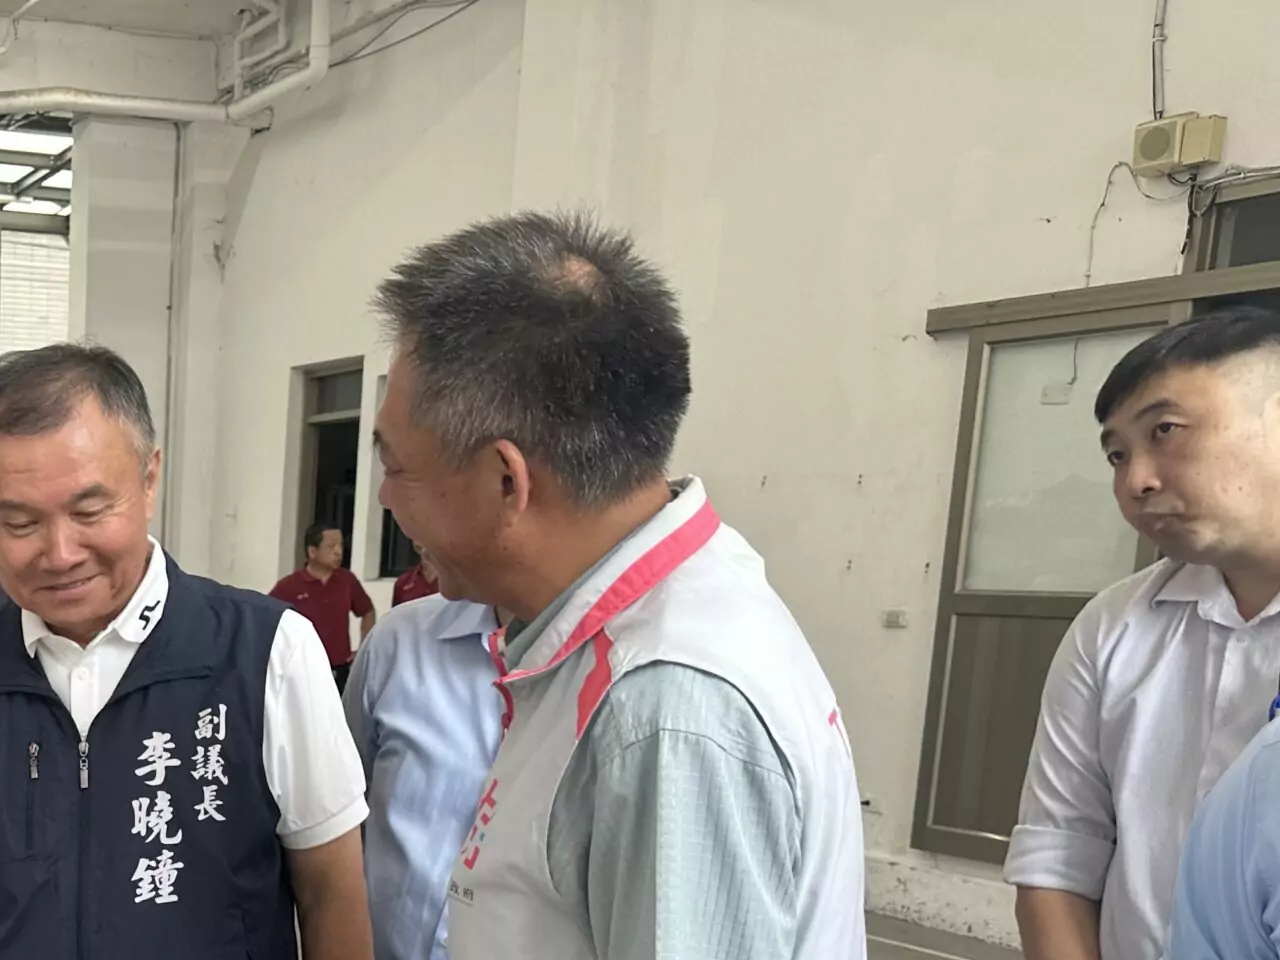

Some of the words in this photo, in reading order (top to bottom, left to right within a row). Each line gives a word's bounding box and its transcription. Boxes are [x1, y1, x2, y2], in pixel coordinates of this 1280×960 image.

[131, 731, 185, 904] 李曉鐘
[190, 703, 229, 821] 副議長
